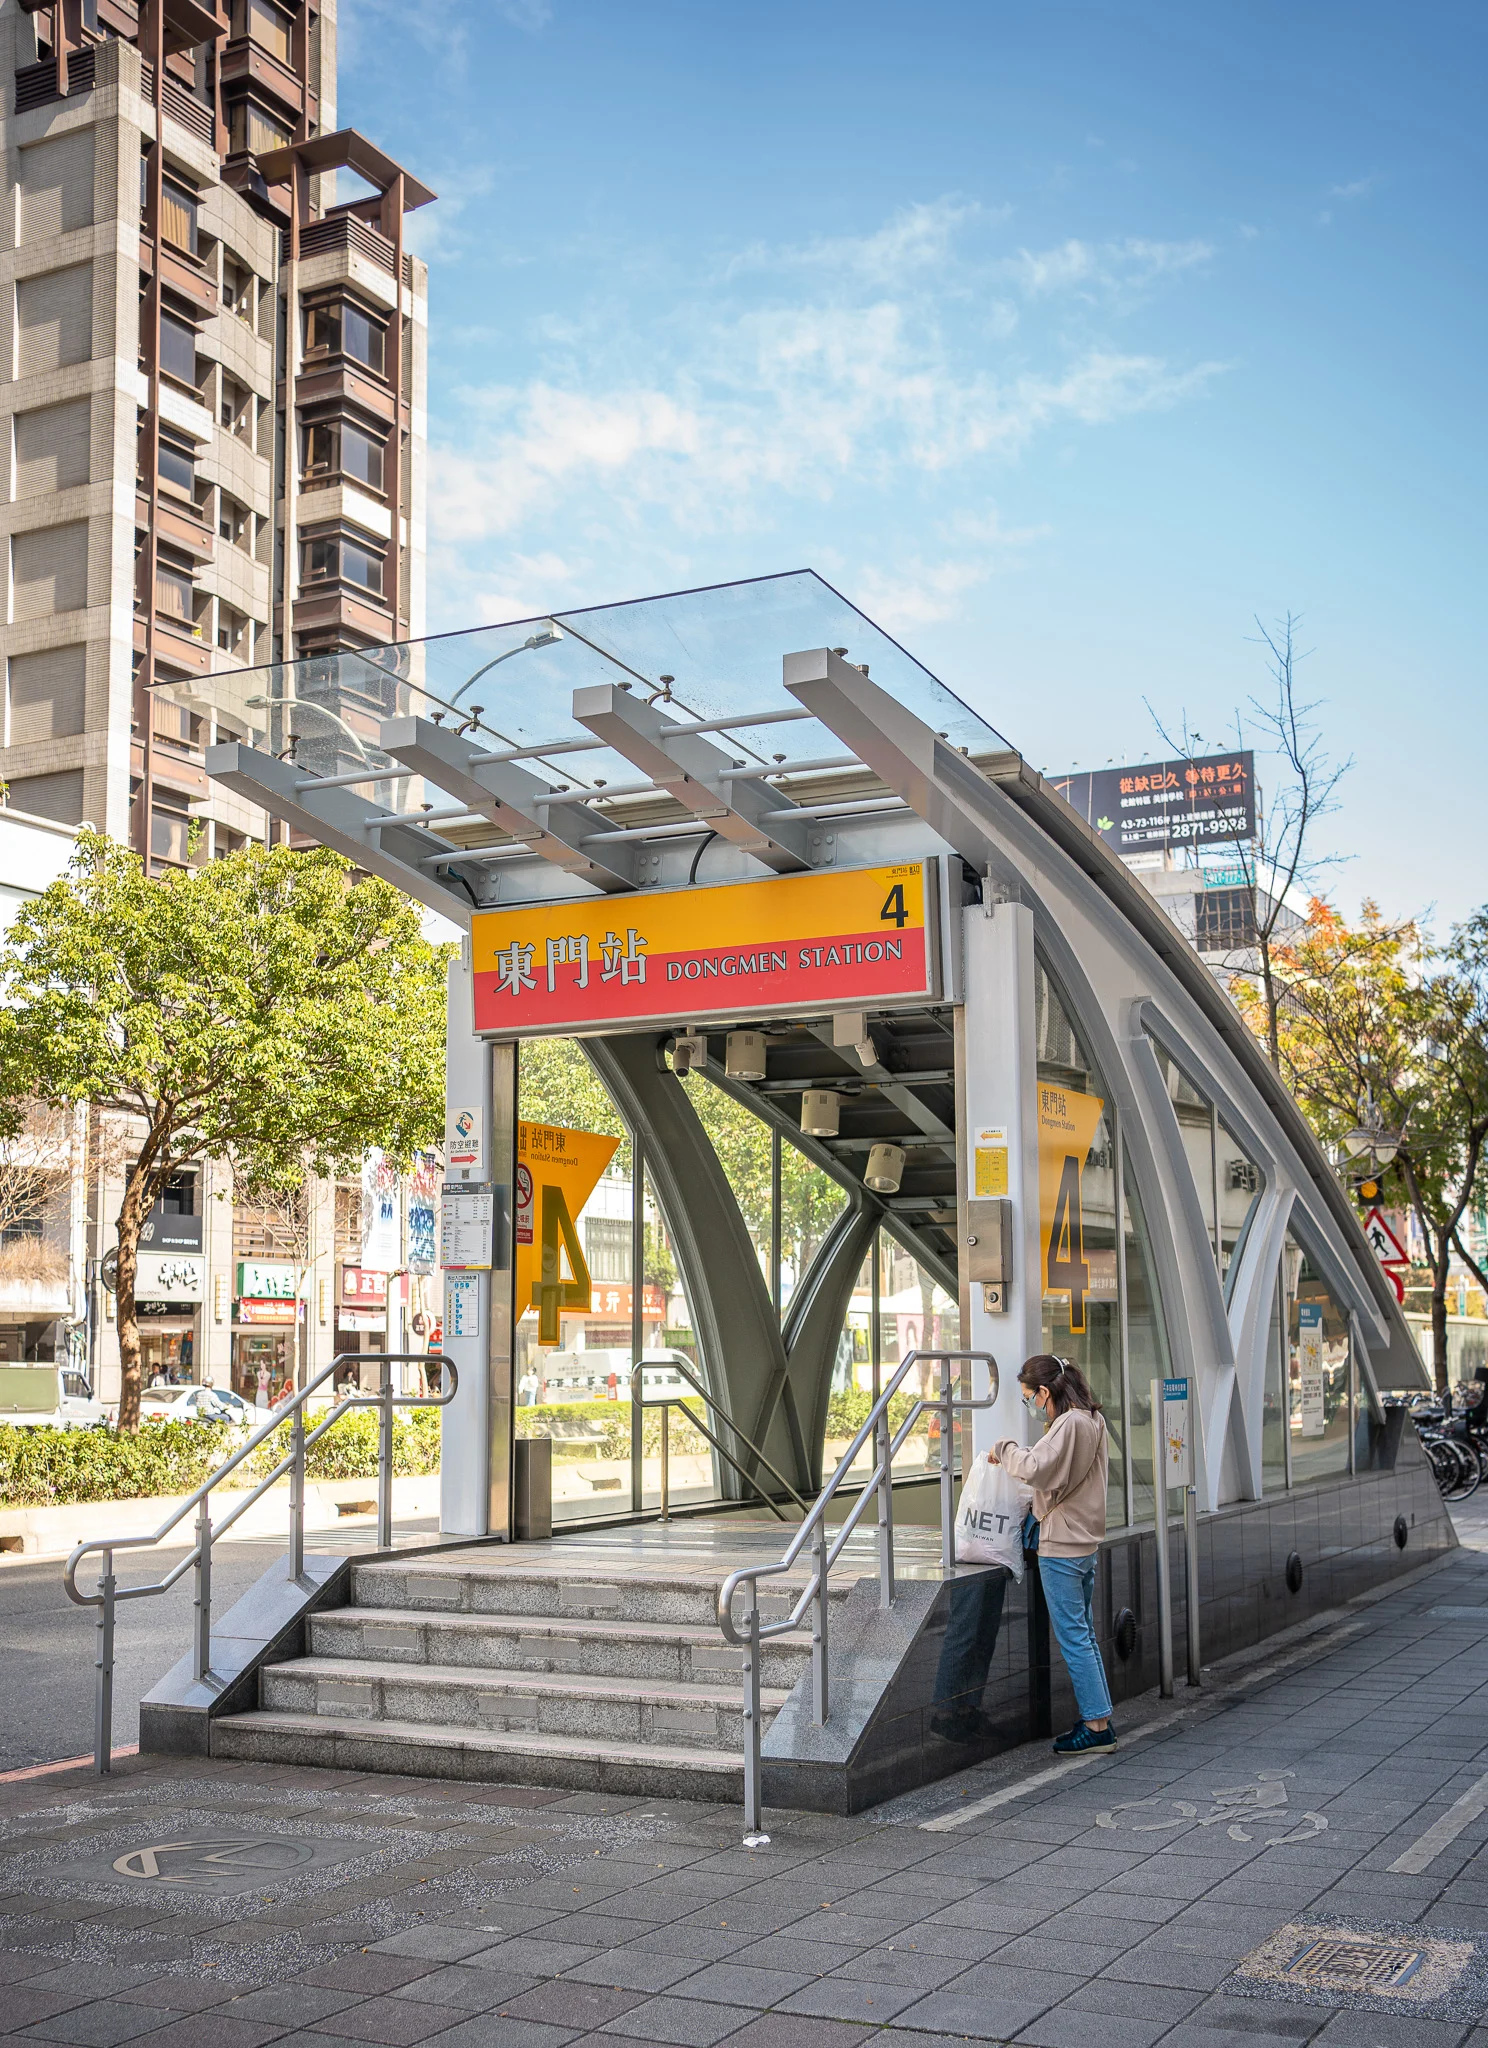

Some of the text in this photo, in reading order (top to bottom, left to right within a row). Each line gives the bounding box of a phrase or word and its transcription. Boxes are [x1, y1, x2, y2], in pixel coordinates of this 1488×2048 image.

[1119, 762, 1248, 794] 從缺已久 等待更久
[880, 883, 909, 928] 4
[493, 928, 648, 996] 東門站
[665, 938, 903, 982] DONGMEN STATION
[1041, 1089, 1067, 1117] 東門站
[1041, 1114, 1076, 1132] Dongmen Station
[1046, 1154, 1090, 1330] 4
[963, 1507, 1010, 1534] NET
[972, 1533, 994, 1542] TAIWAN
